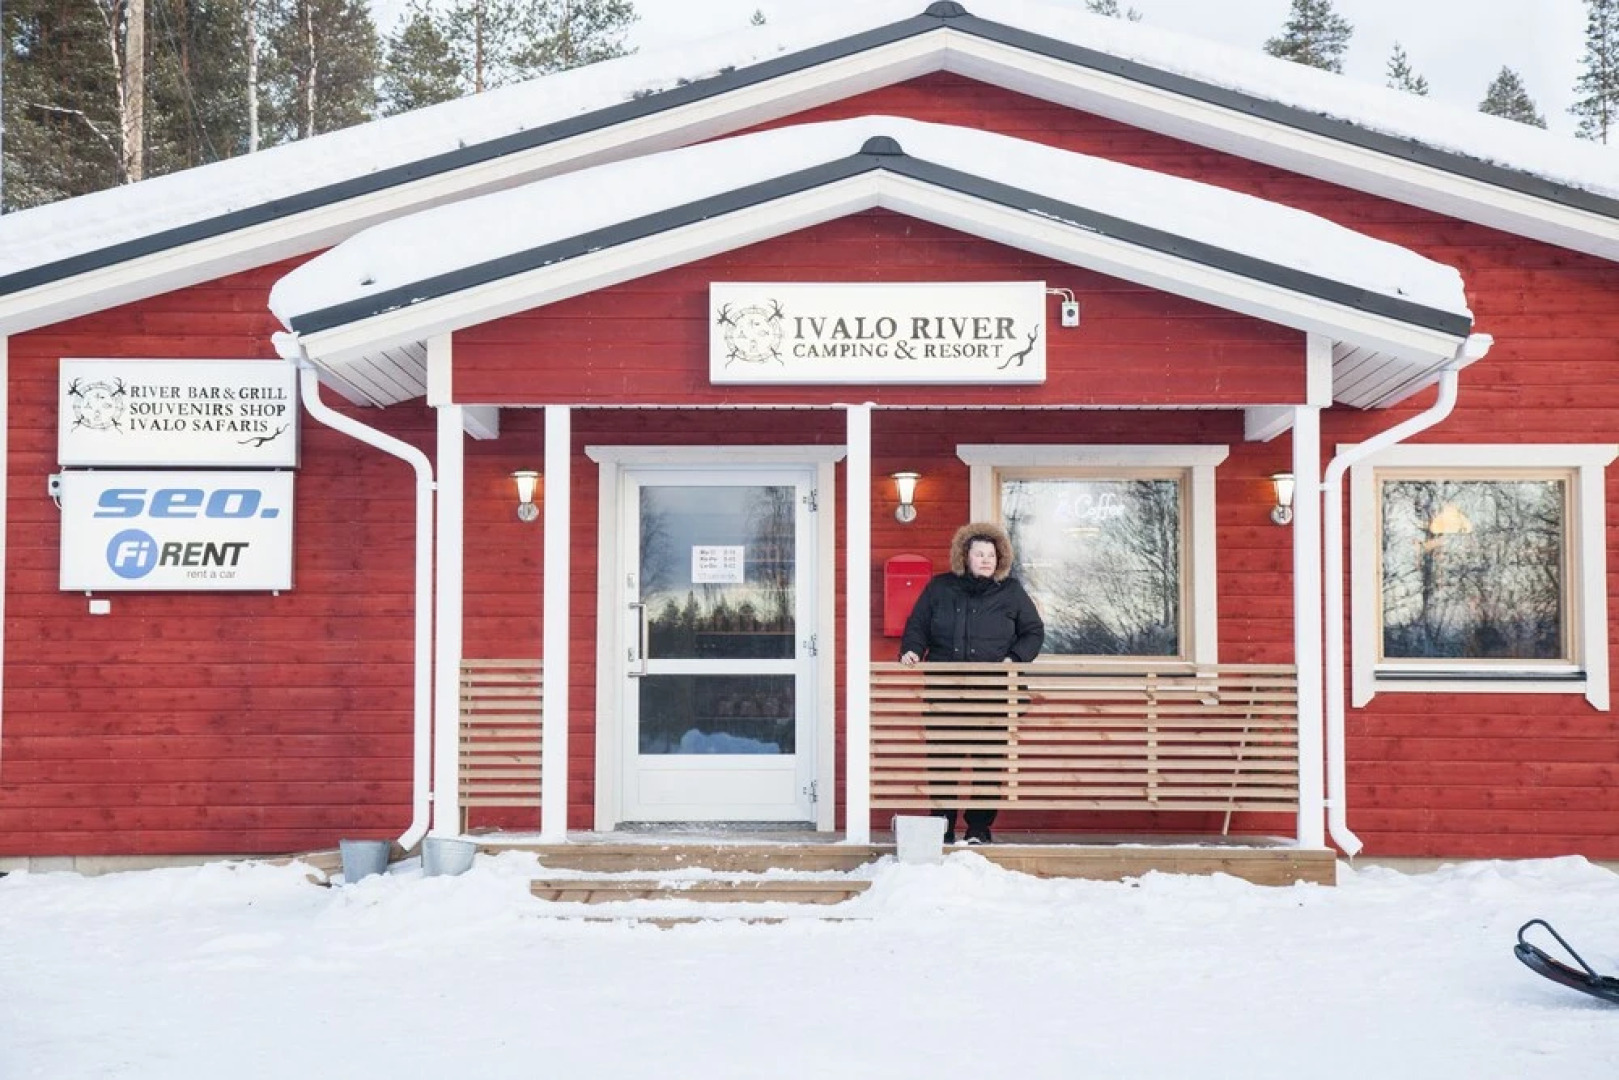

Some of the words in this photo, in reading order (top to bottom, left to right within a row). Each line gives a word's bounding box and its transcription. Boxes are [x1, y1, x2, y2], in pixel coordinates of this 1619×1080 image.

[793, 316, 898, 339] IVALO
[910, 316, 1017, 339] RIVER
[793, 343, 888, 358] CAMPING
[924, 343, 1003, 358] RESORT
[130, 386, 181, 399] RIVER
[130, 402, 234, 417] SOUVENIRS
[240, 404, 286, 417] SHOP
[130, 418, 186, 431] IVALO
[192, 419, 268, 432] SAFARIS
[187, 570, 207, 579] rent
[210, 571, 217, 579] a
[219, 571, 236, 579] car
